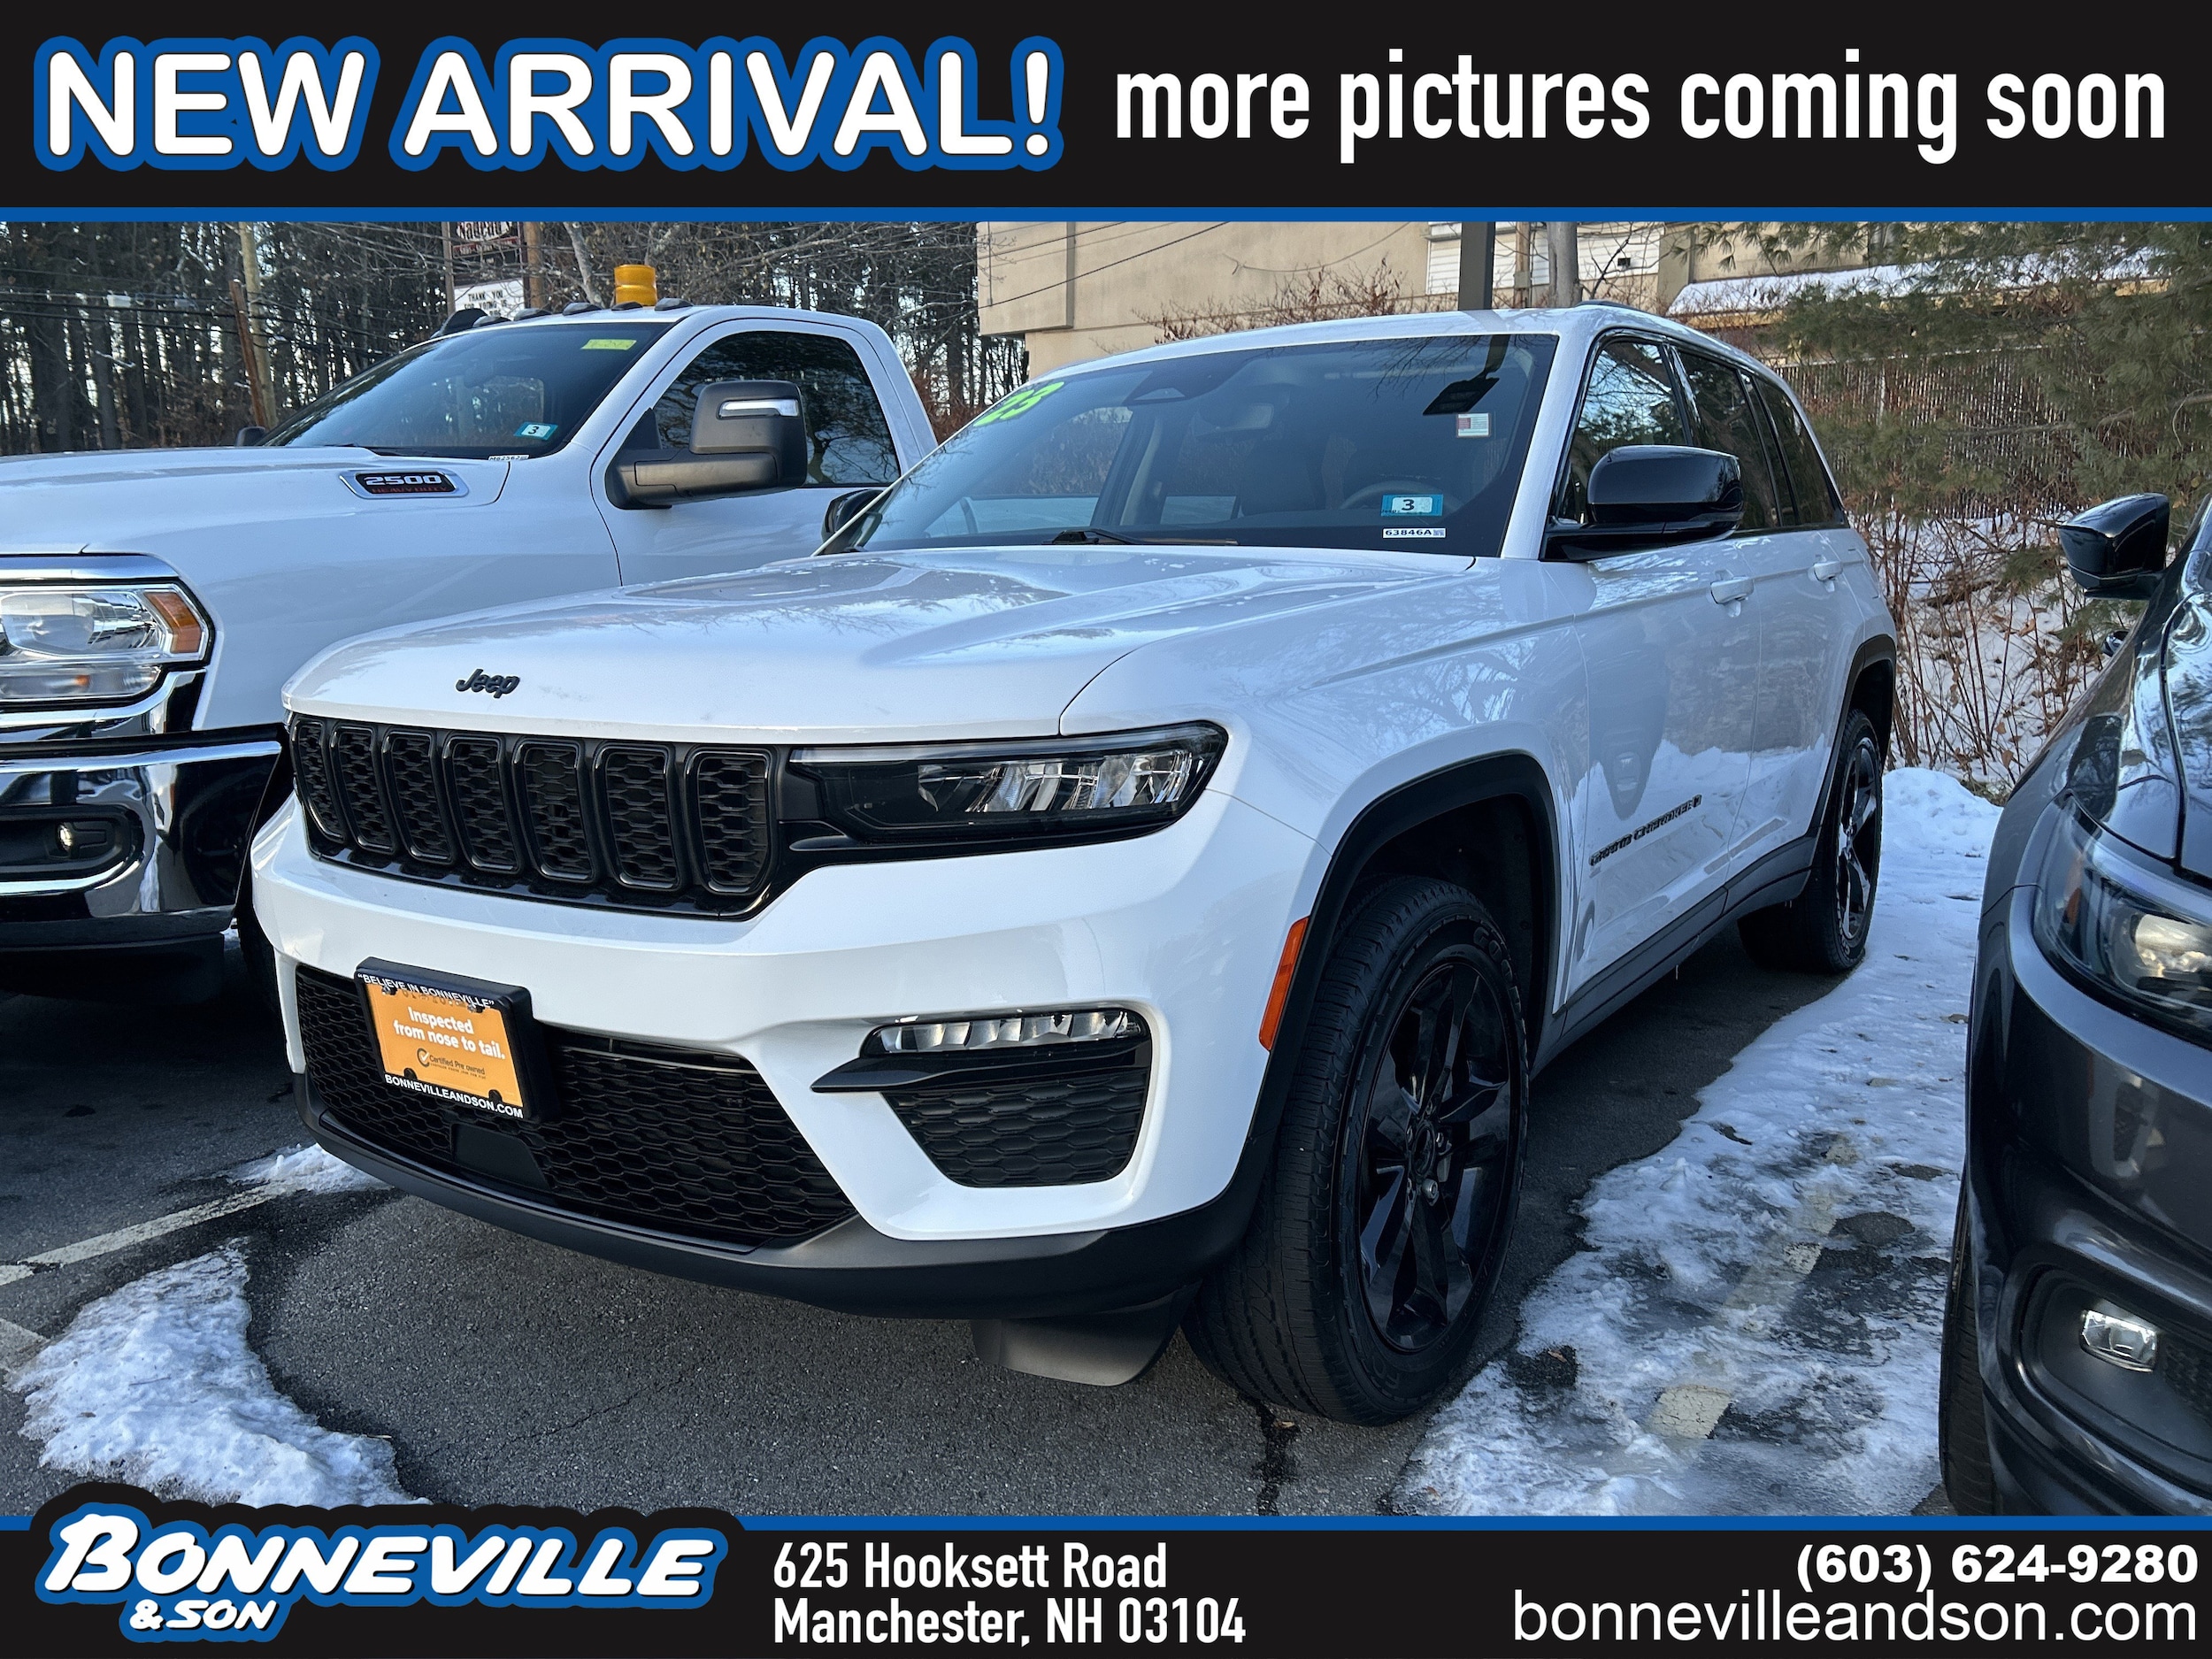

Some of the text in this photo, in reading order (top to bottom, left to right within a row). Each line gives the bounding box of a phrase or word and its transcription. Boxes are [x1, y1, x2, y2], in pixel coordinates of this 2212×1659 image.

[527, 426, 540, 434] 3
[364, 474, 442, 486] 2500
[1402, 499, 1415, 511] 3
[456, 668, 520, 699] Jeep
[406, 983, 420, 994] IN
[407, 1006, 474, 1035] Inspected
[393, 1019, 506, 1060] from nose to tail.
[384, 1073, 524, 1119] BONNEVILLEANDSON.COM
